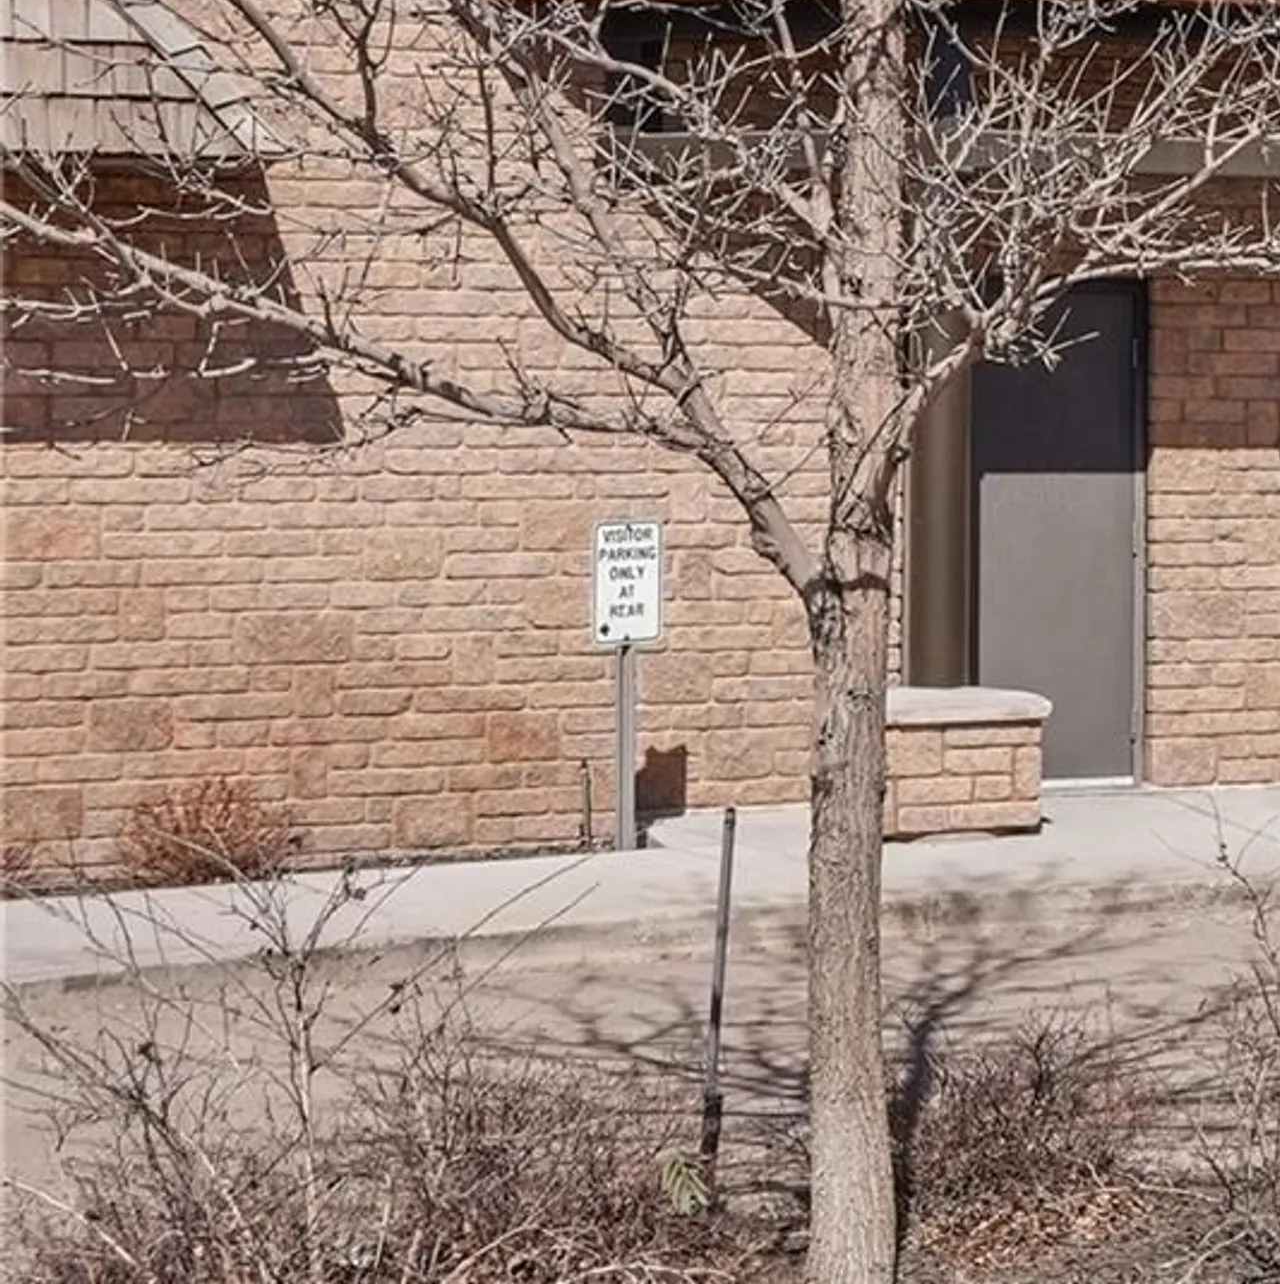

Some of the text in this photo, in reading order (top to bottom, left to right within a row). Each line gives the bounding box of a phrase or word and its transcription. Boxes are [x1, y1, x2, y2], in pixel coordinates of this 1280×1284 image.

[602, 527, 654, 542] VISITOR
[599, 545, 656, 560] PARKING
[609, 564, 645, 580] ONLY
[618, 583, 635, 598] AT
[609, 602, 645, 617] REAR
